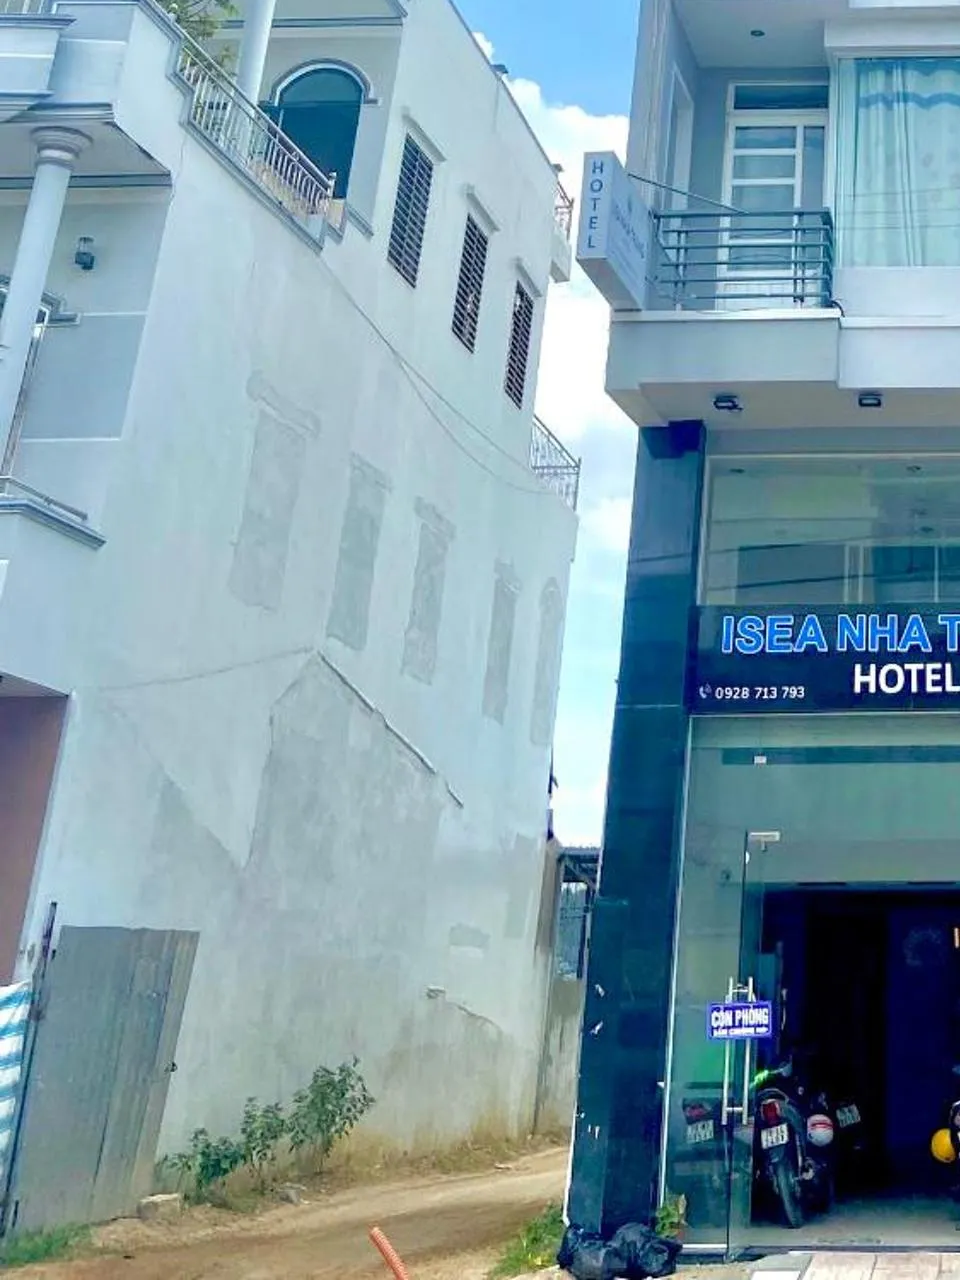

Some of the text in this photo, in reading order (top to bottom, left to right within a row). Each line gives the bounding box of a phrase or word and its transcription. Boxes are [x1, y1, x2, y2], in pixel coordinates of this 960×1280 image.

[588, 160, 604, 248] HOTEL
[721, 614, 828, 654] ISEA
[836, 614, 932, 652] NHA
[715, 686, 805, 699] 0928 713 793
[853, 663, 960, 694] HOTEL
